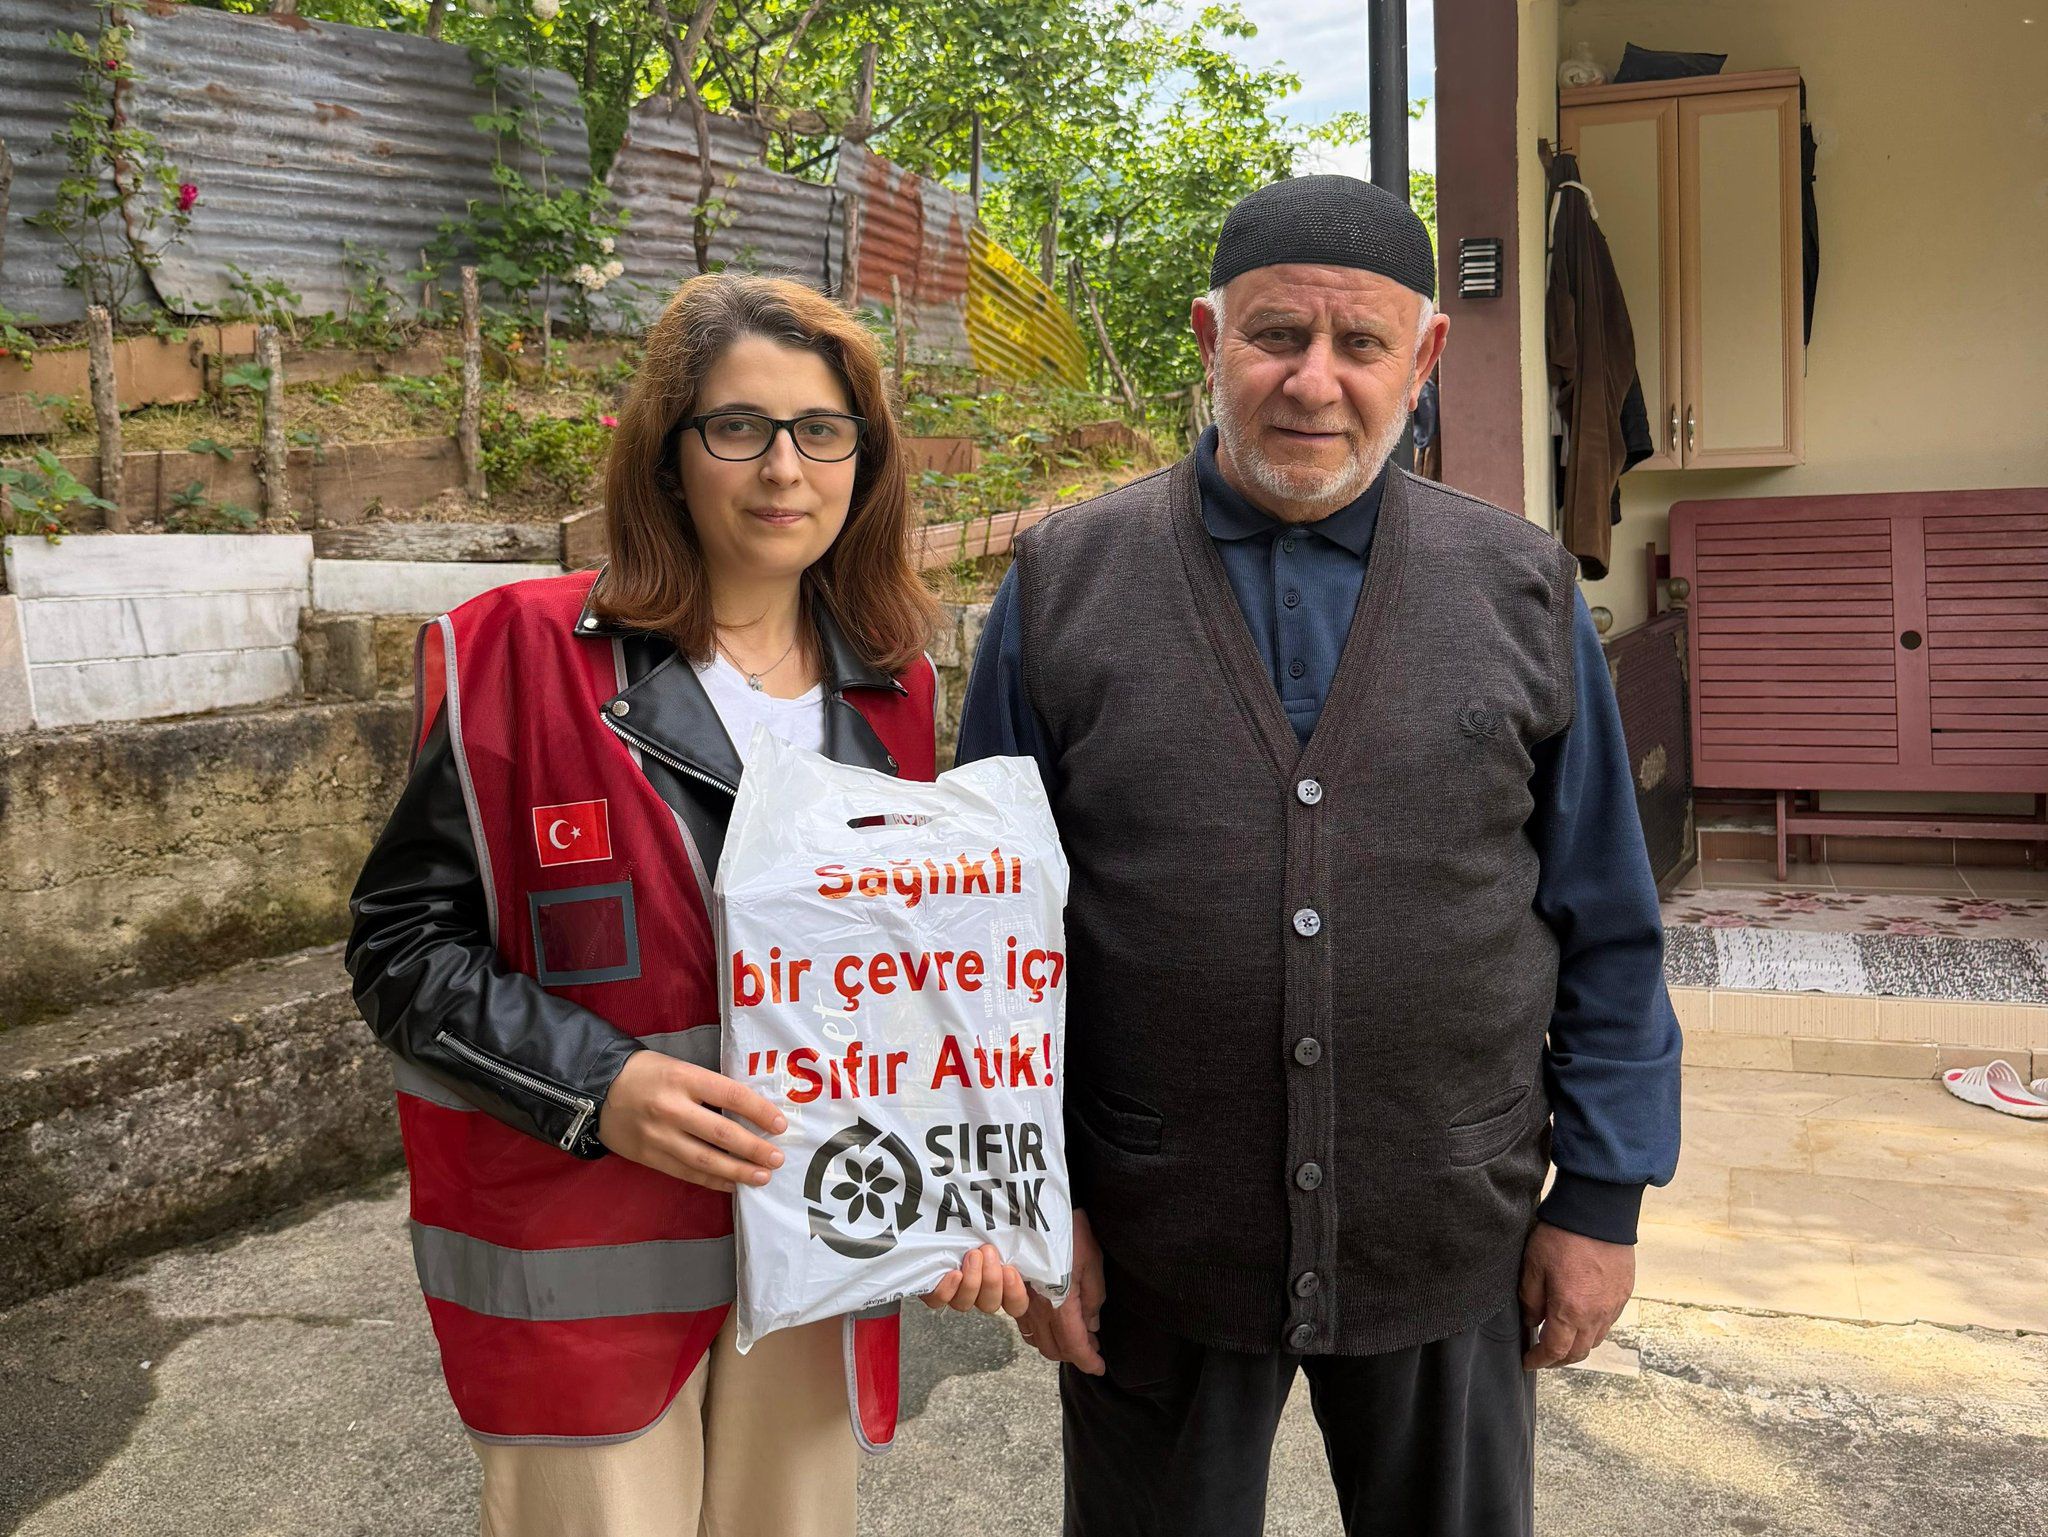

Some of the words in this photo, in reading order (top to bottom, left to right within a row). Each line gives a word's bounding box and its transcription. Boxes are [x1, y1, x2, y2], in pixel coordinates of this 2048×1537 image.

[732, 946, 812, 1007] bir
[833, 950, 985, 1012] çevre
[925, 1122, 1048, 1178] SIFIR
[935, 1177, 1051, 1233] ATIK
